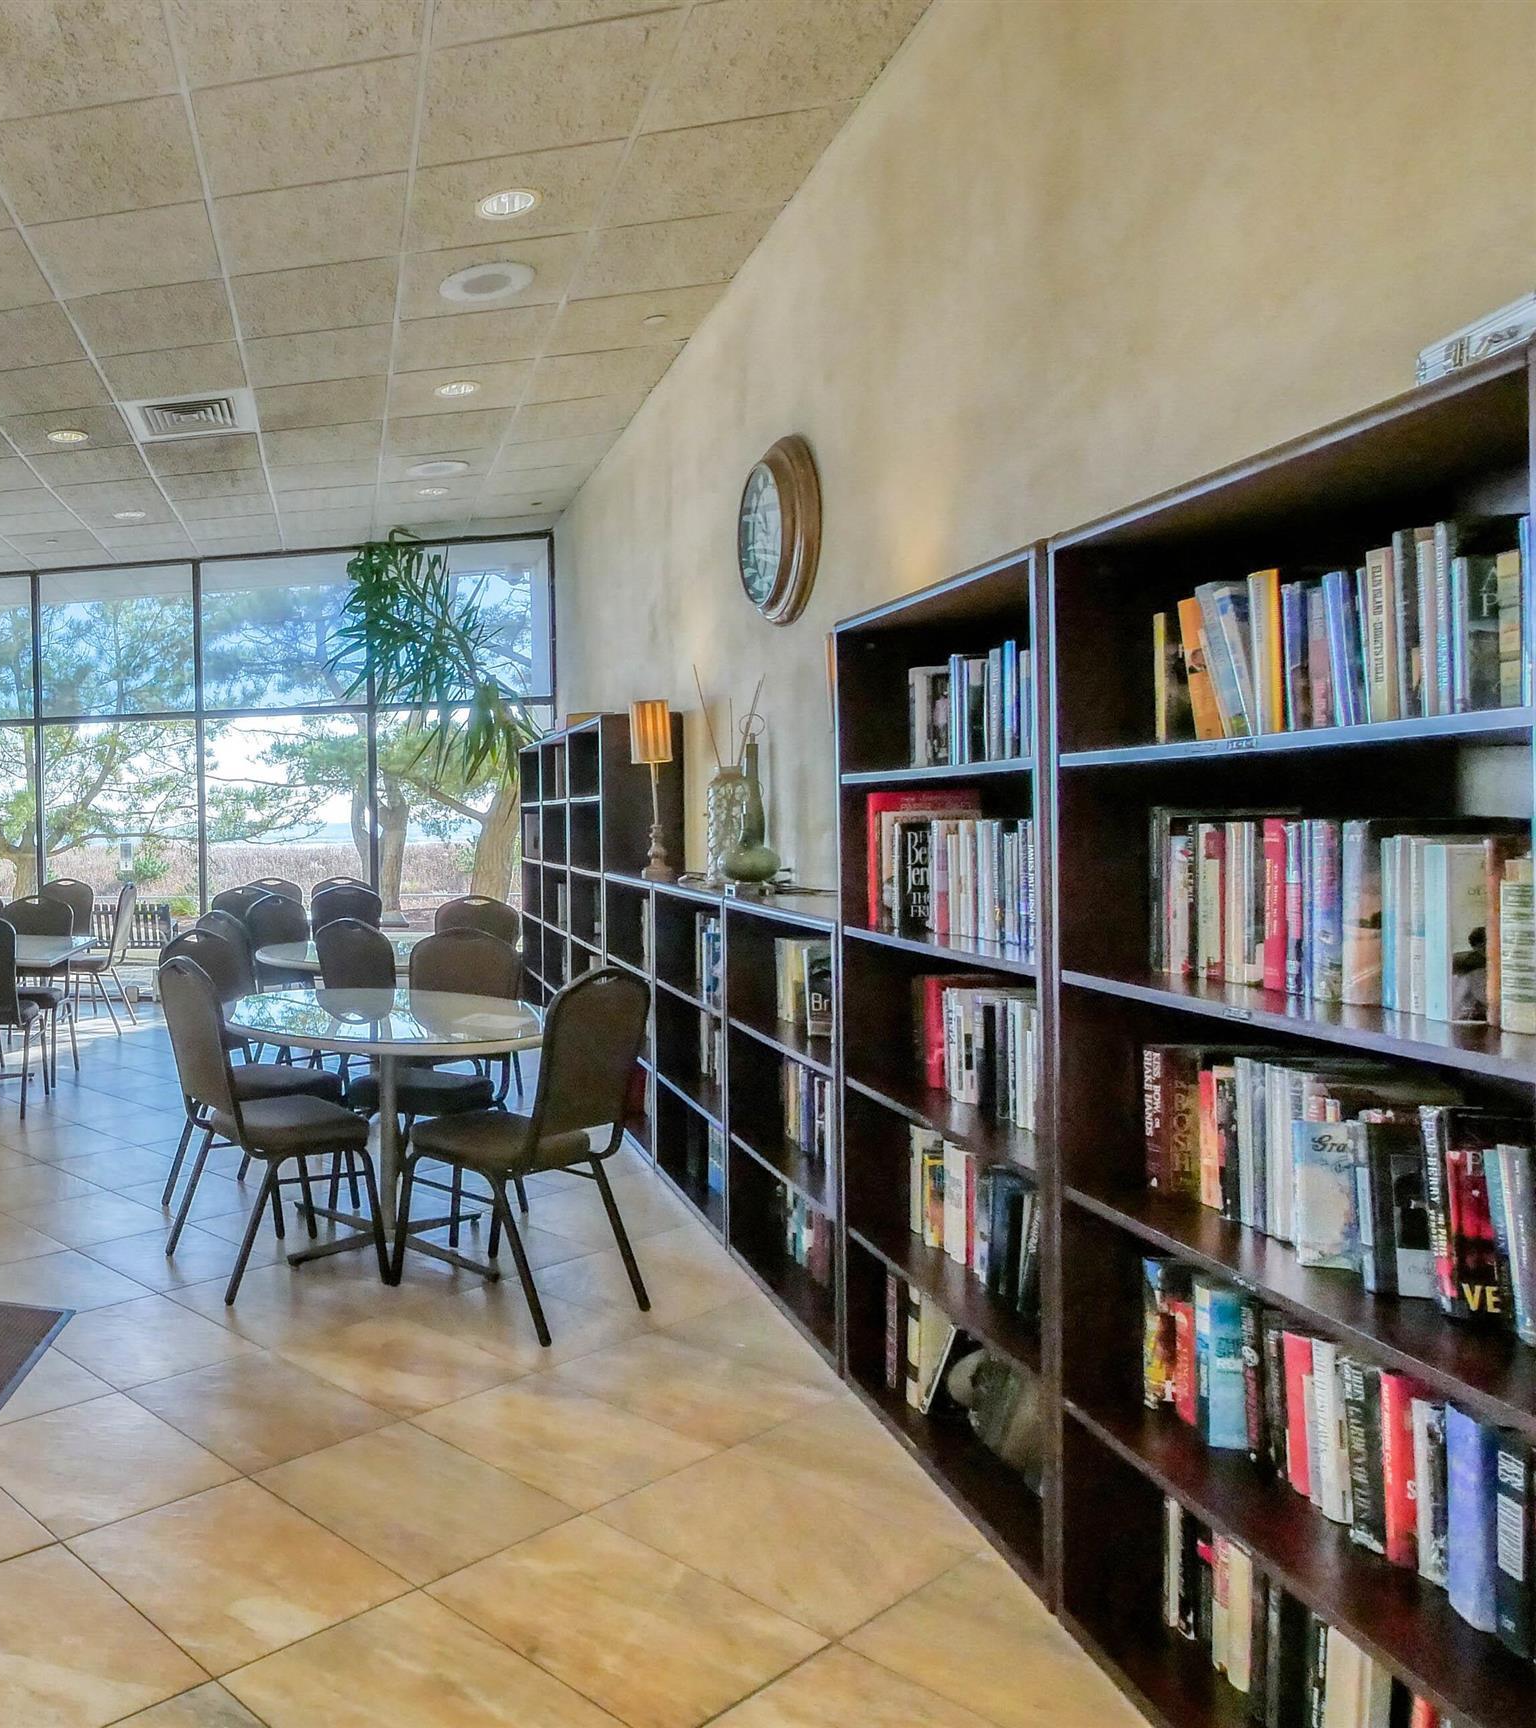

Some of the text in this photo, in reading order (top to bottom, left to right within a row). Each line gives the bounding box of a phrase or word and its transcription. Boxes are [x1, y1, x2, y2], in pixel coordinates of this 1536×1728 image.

[1371, 564, 1382, 588] ELLIS
[1373, 588, 1383, 616] ISLAND
[1027, 844, 1036, 923] JAMES PATTERSON
[1152, 1052, 1161, 1080] KISS,
[1143, 1049, 1154, 1137] SHAKE HANDS
[1152, 1085, 1161, 1114] BOW,
[1426, 1156, 1440, 1204] BERRY
[1380, 1383, 1393, 1485] MARY HIGGINS CLARK
